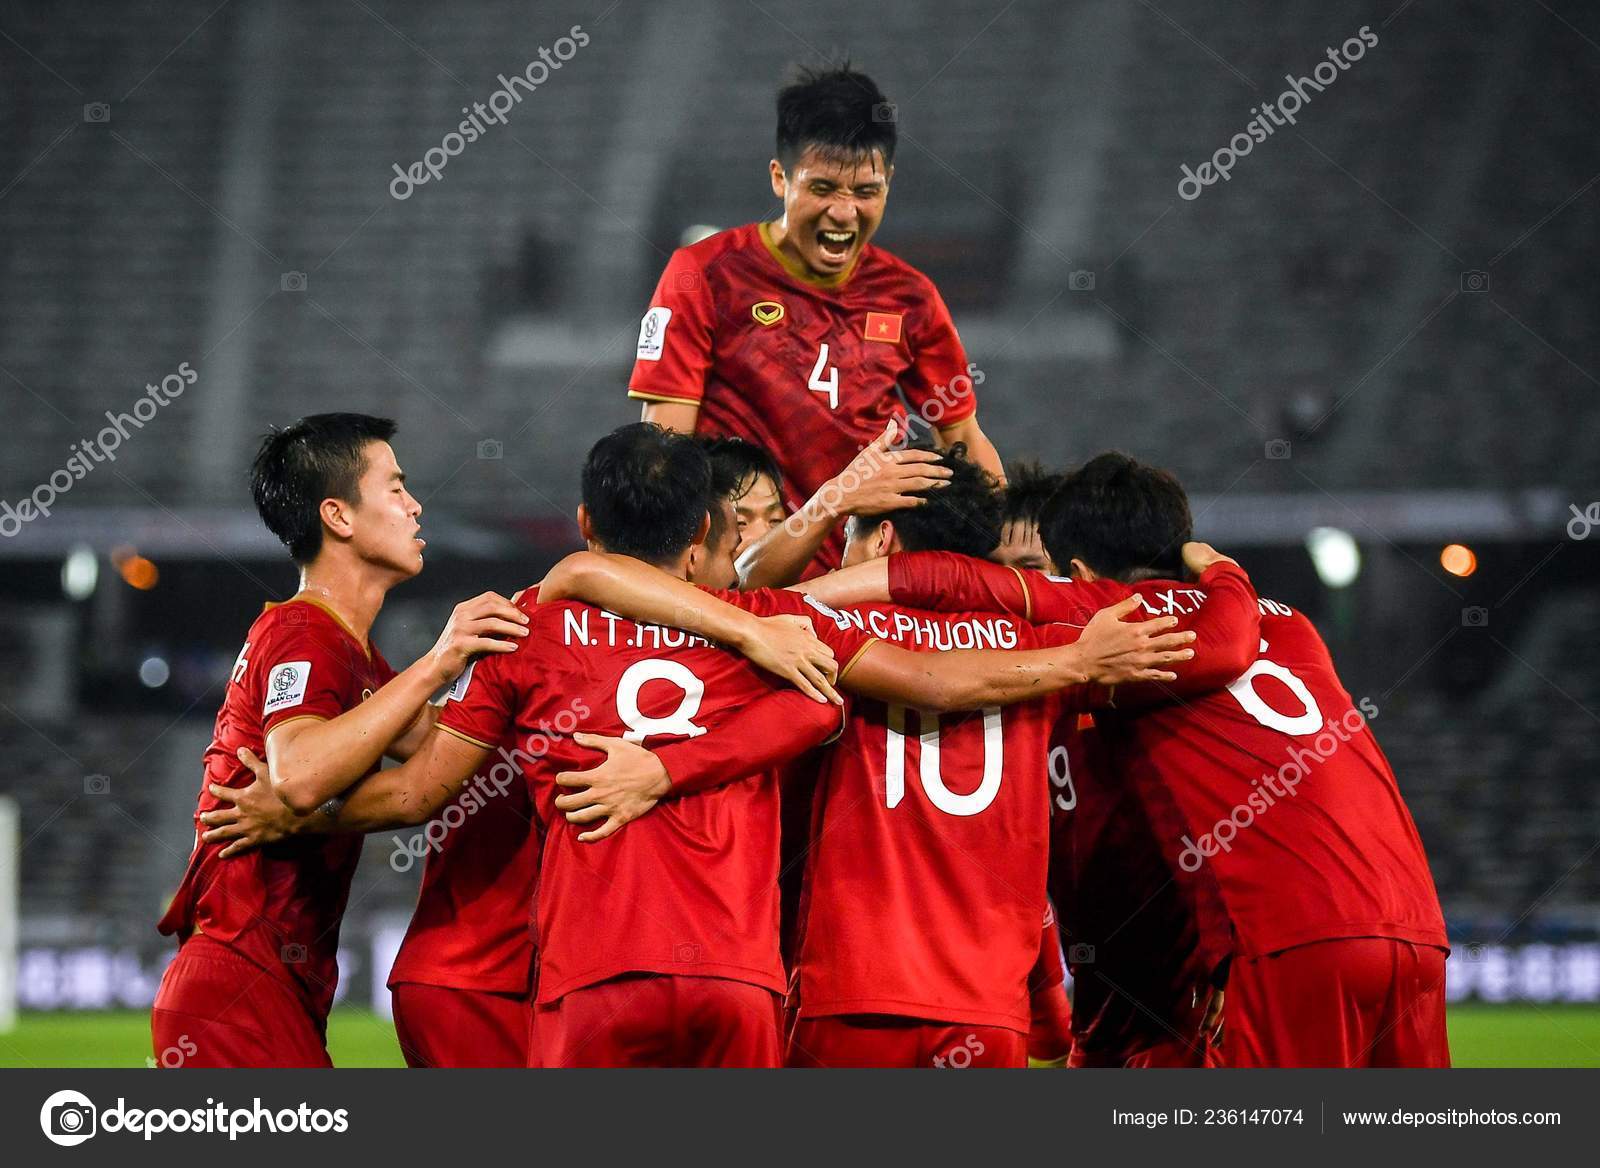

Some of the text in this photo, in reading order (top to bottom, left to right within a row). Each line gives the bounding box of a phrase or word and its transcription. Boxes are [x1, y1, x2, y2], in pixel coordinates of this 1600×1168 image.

[808, 344, 839, 409] 4
[838, 608, 1018, 651] N.C.PHUONG
[616, 658, 707, 745] 8
[1225, 638, 1324, 736] 6
[886, 703, 1004, 817] 10
